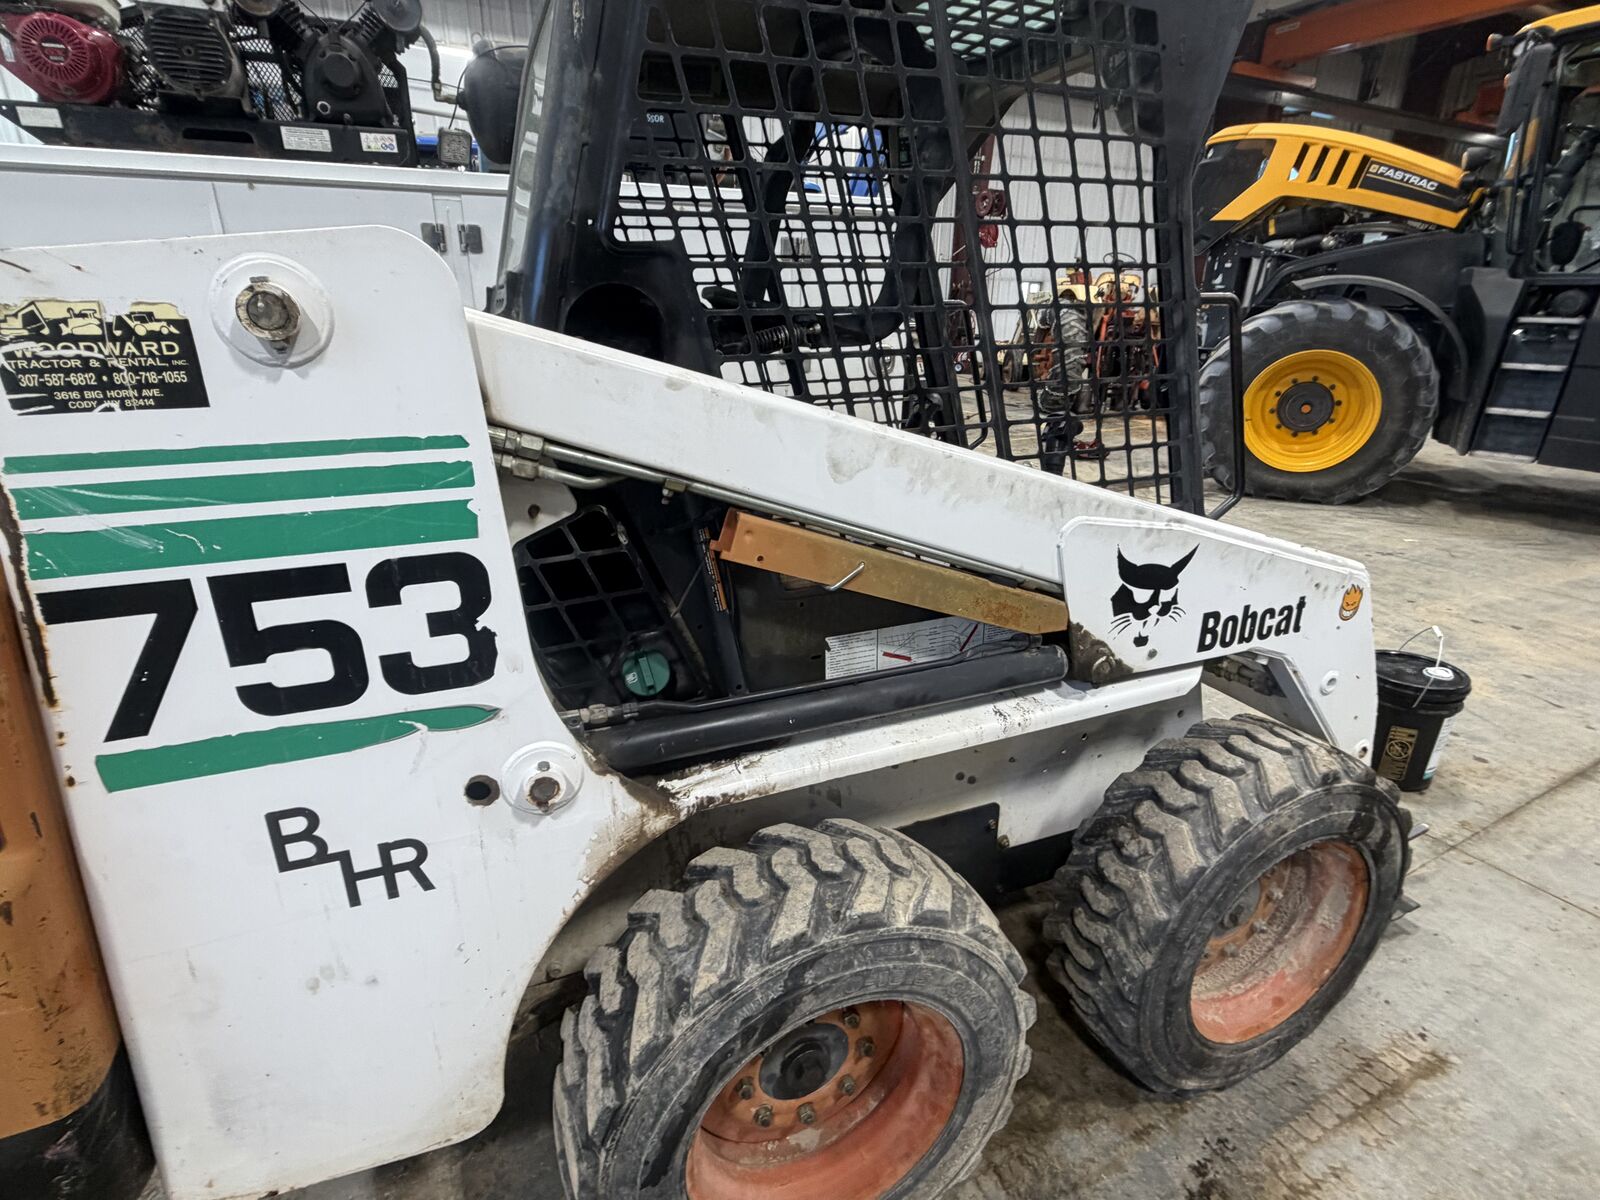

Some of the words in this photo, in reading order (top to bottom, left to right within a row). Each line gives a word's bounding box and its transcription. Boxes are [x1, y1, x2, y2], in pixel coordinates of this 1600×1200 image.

[1377, 165, 1439, 191] FASTRAC
[8, 359, 82, 369] TRACTOR
[89, 359, 101, 368] &
[17, 373, 98, 387] 307-587-6812
[112, 371, 188, 385] 800-718-1055
[53, 391, 81, 400] 3616
[83, 390, 104, 399] BIG
[106, 389, 138, 398] HORN
[141, 388, 164, 397] AVE.
[68, 401, 97, 409] CODY
[1196, 595, 1306, 654] Bobcat
[35, 551, 498, 742] 753
